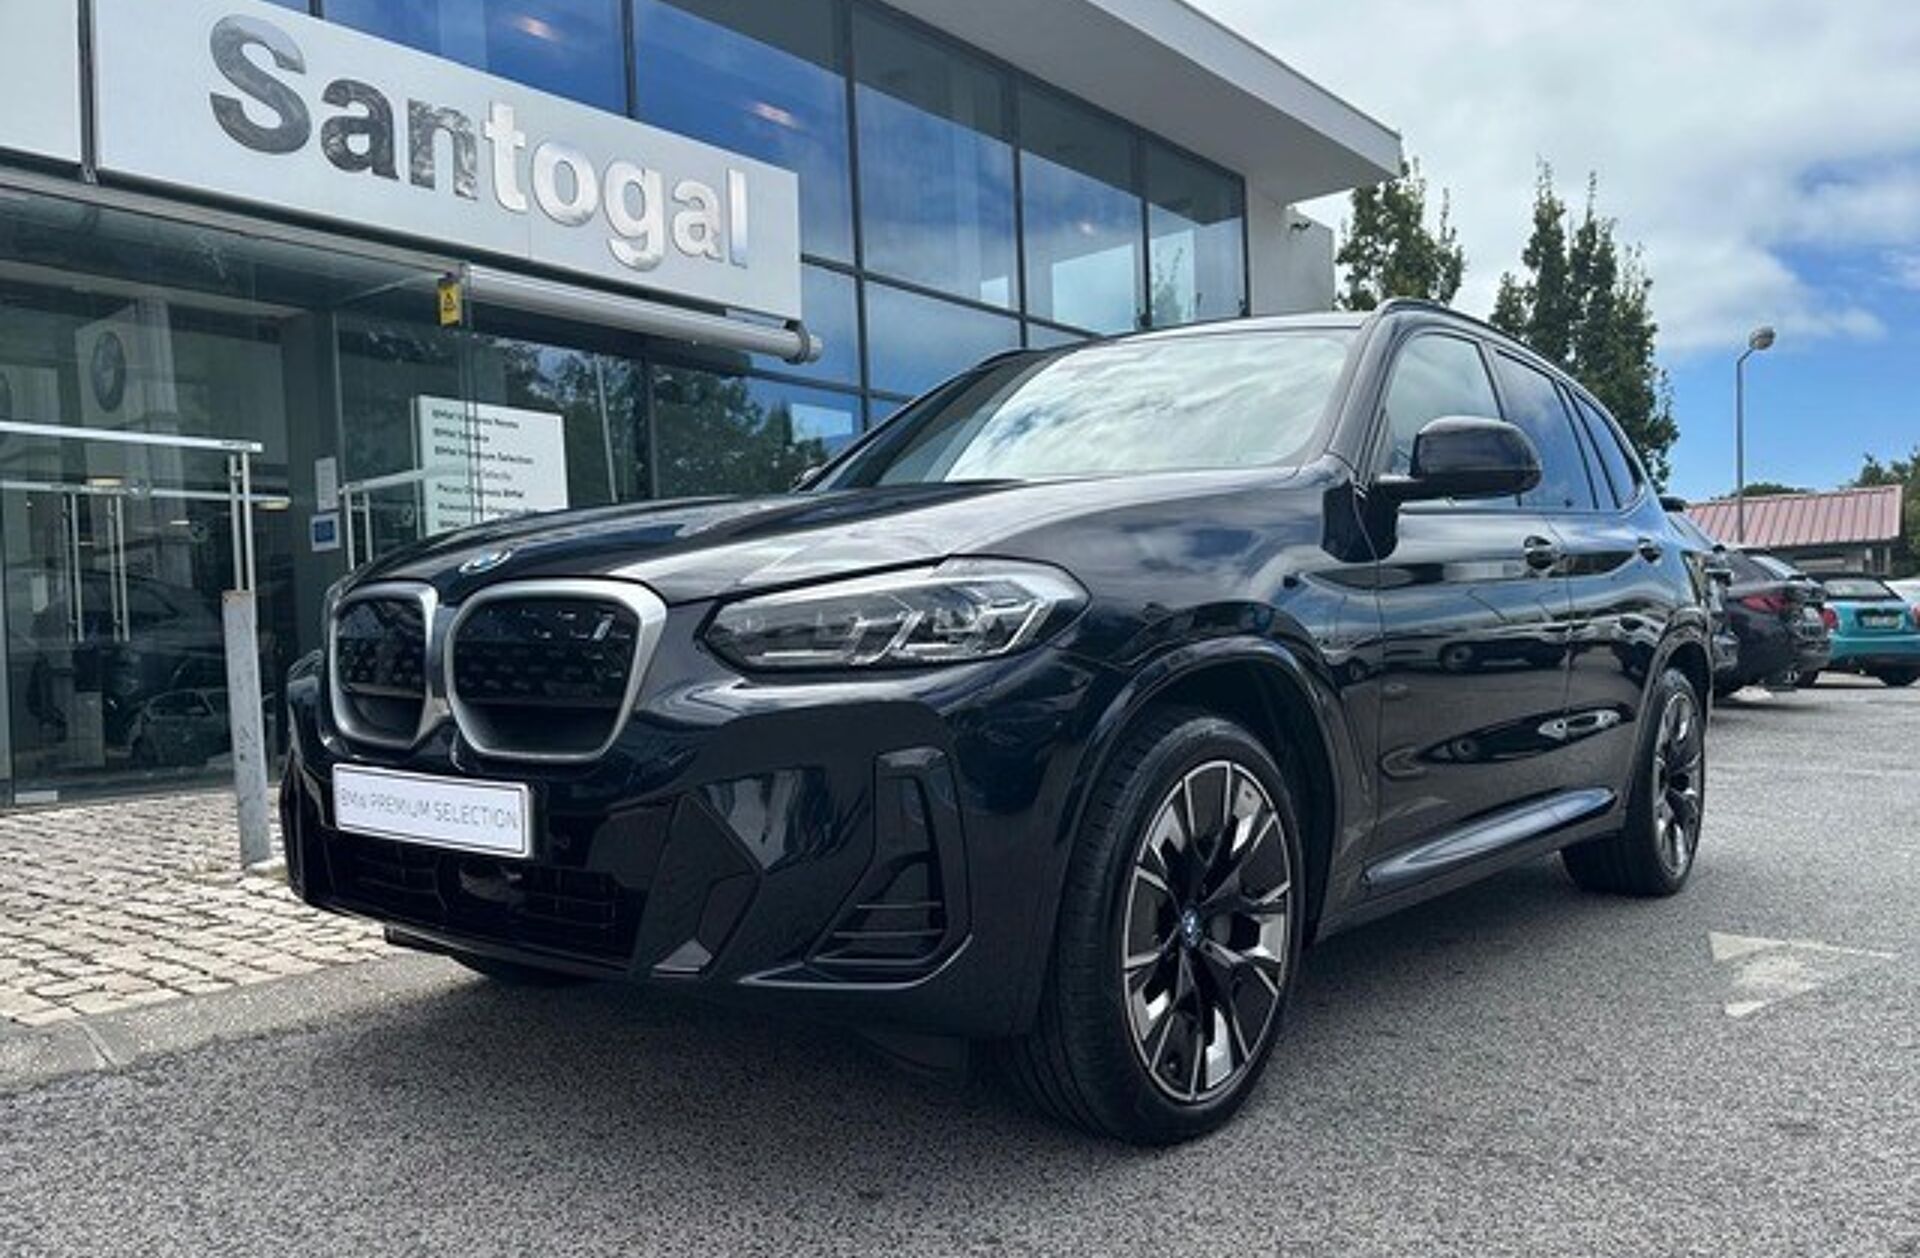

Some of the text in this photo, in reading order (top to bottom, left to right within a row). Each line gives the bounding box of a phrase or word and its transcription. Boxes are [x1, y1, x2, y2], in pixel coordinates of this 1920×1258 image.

[209, 12, 749, 272] Santogal
[370, 792, 431, 819] PREMIUM
[433, 801, 519, 830] SELECTION
